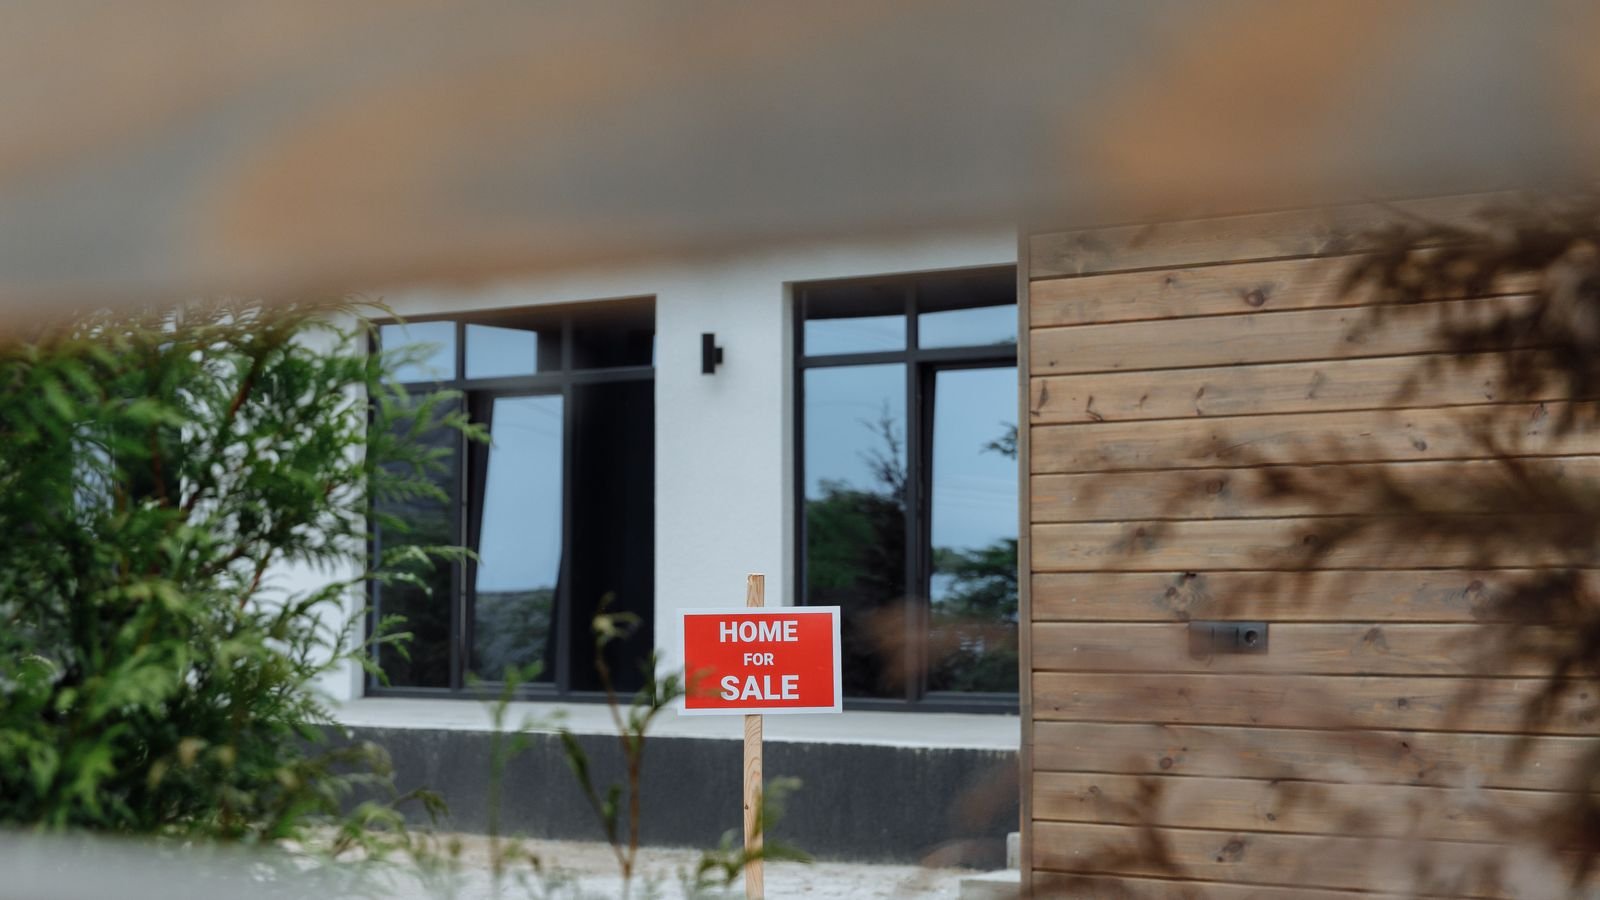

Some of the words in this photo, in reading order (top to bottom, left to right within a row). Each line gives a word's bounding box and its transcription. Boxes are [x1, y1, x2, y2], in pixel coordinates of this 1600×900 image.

[719, 620, 798, 643] HOME
[743, 652, 774, 666] FOR
[720, 674, 800, 701] SALE
